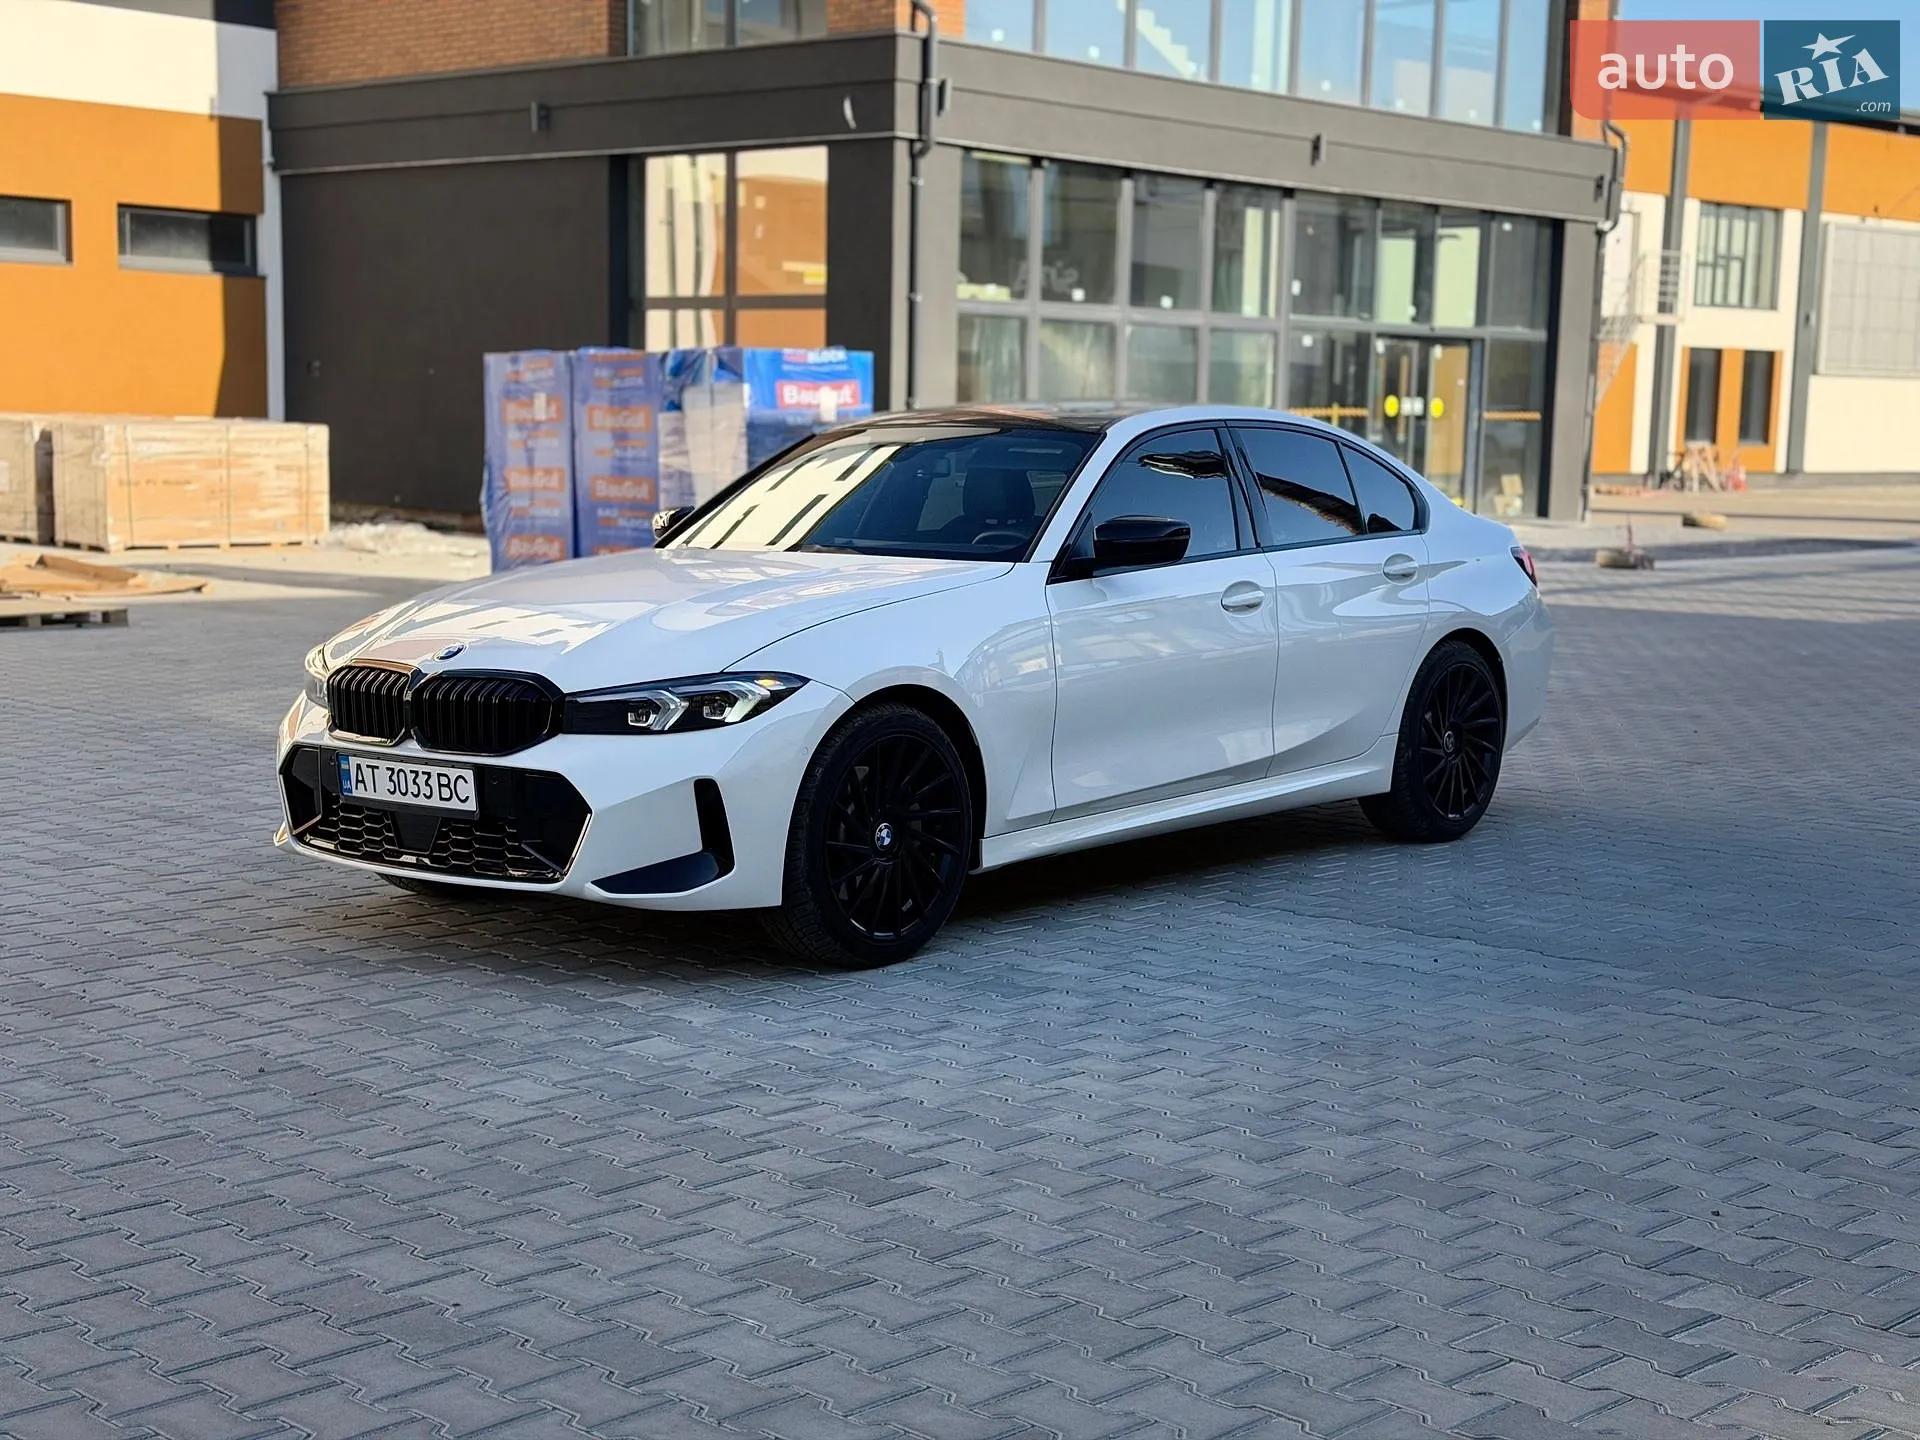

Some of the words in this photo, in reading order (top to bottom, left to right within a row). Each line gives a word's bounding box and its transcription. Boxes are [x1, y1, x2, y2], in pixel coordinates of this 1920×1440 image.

[783, 385, 852, 405] Bauut
[354, 762, 379, 793] AT
[385, 766, 433, 800] 3033
[436, 772, 470, 804] BC
